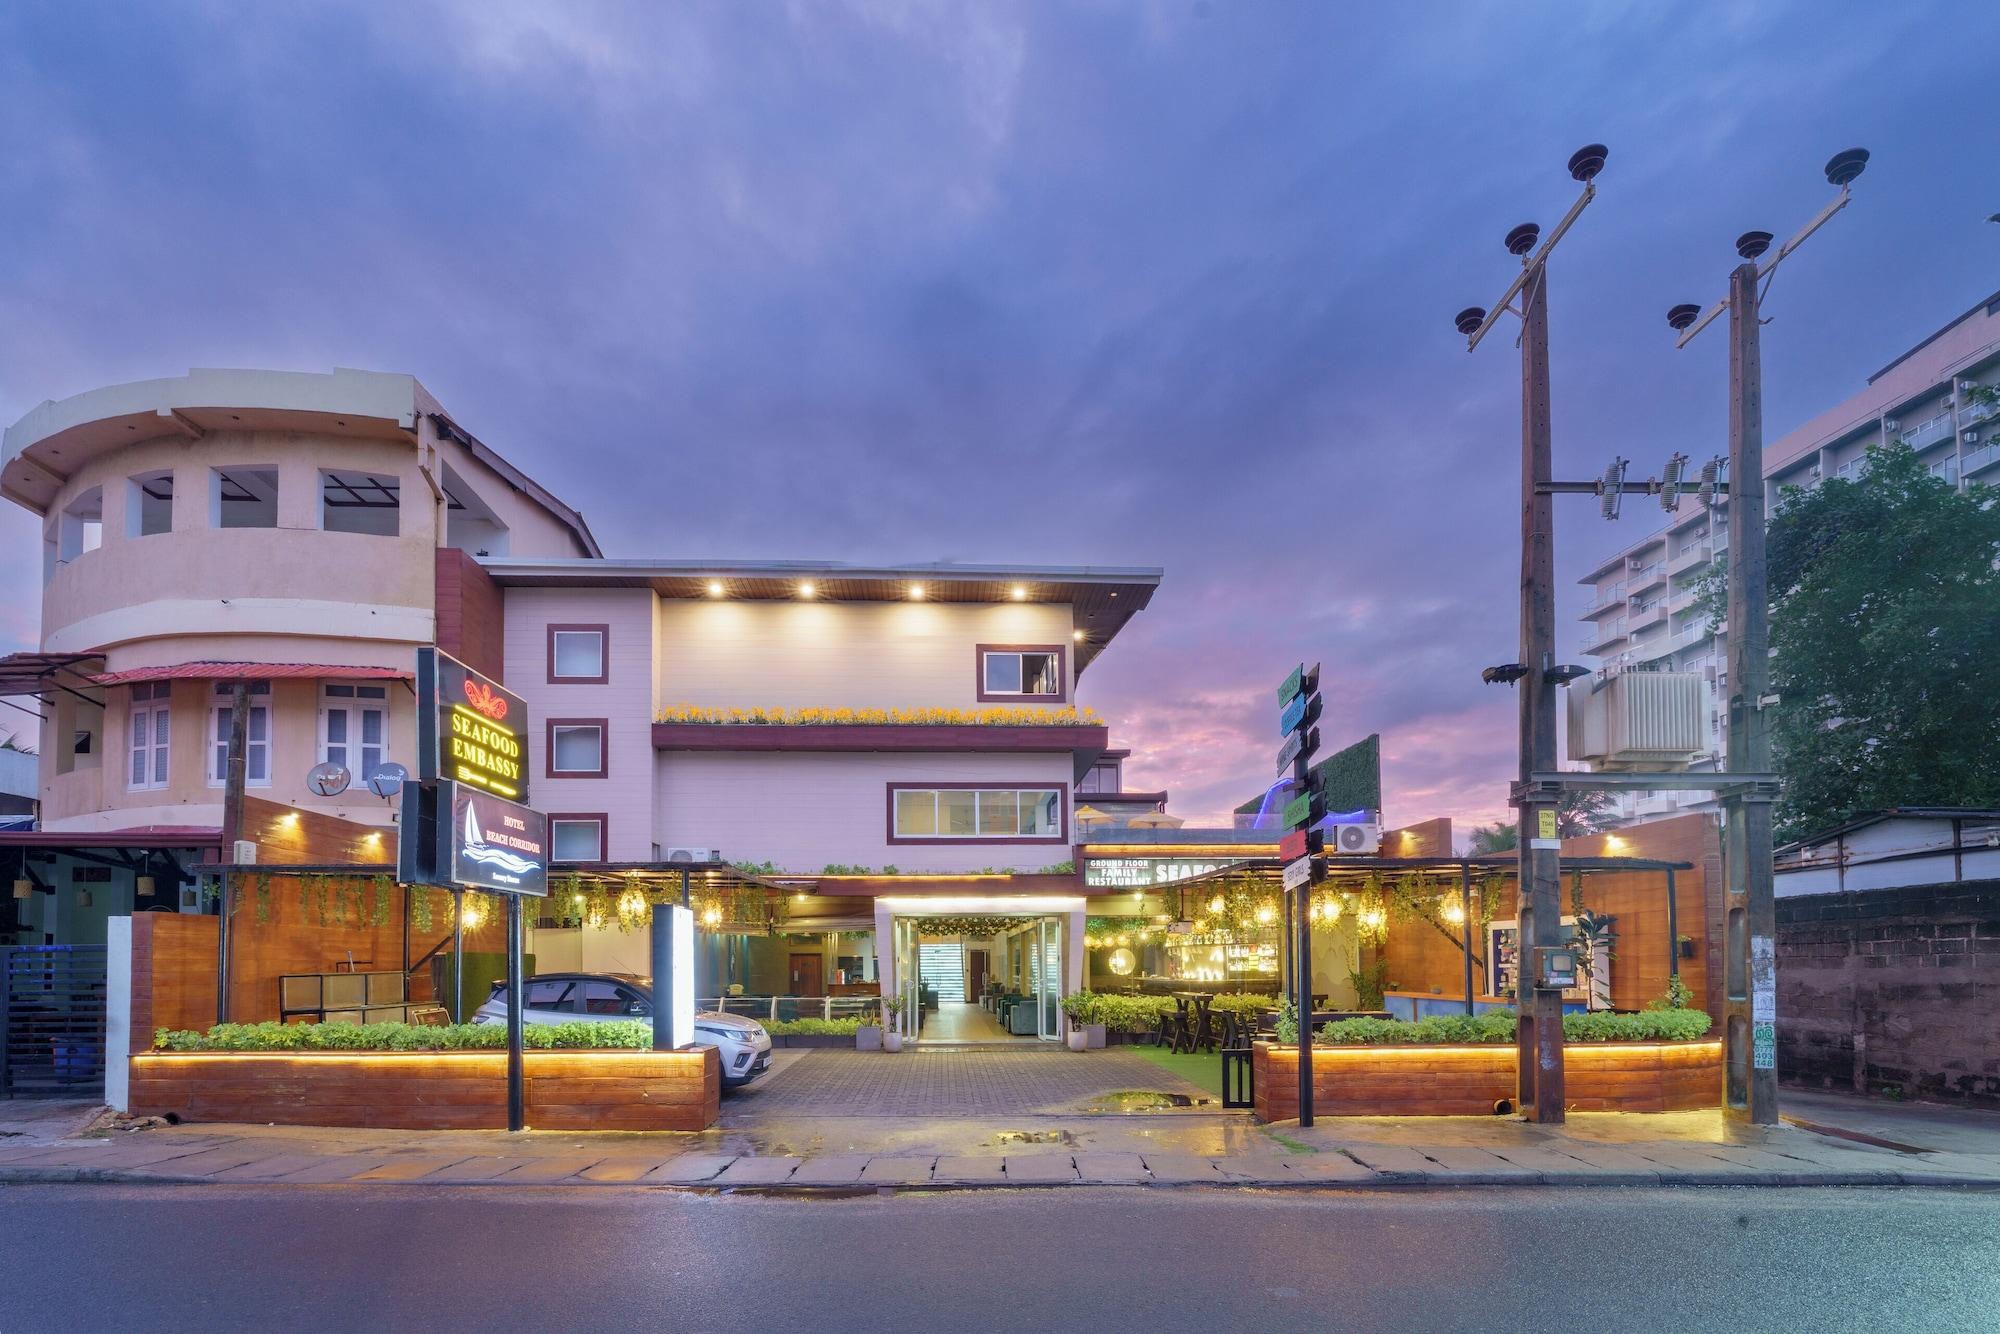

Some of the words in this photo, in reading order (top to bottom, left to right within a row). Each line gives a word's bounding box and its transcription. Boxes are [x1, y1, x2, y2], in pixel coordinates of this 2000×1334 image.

[452, 713, 519, 758] SEAFOOD
[453, 737, 519, 780] EMBASSY
[504, 815, 525, 831] HOTEL
[486, 830, 508, 845] BEACH
[509, 836, 540, 854] CORRIDOR
[1101, 868, 1137, 877] FAMILY
[1088, 877, 1151, 886] RESTAURANT
[1755, 1052, 1773, 1060] 403
